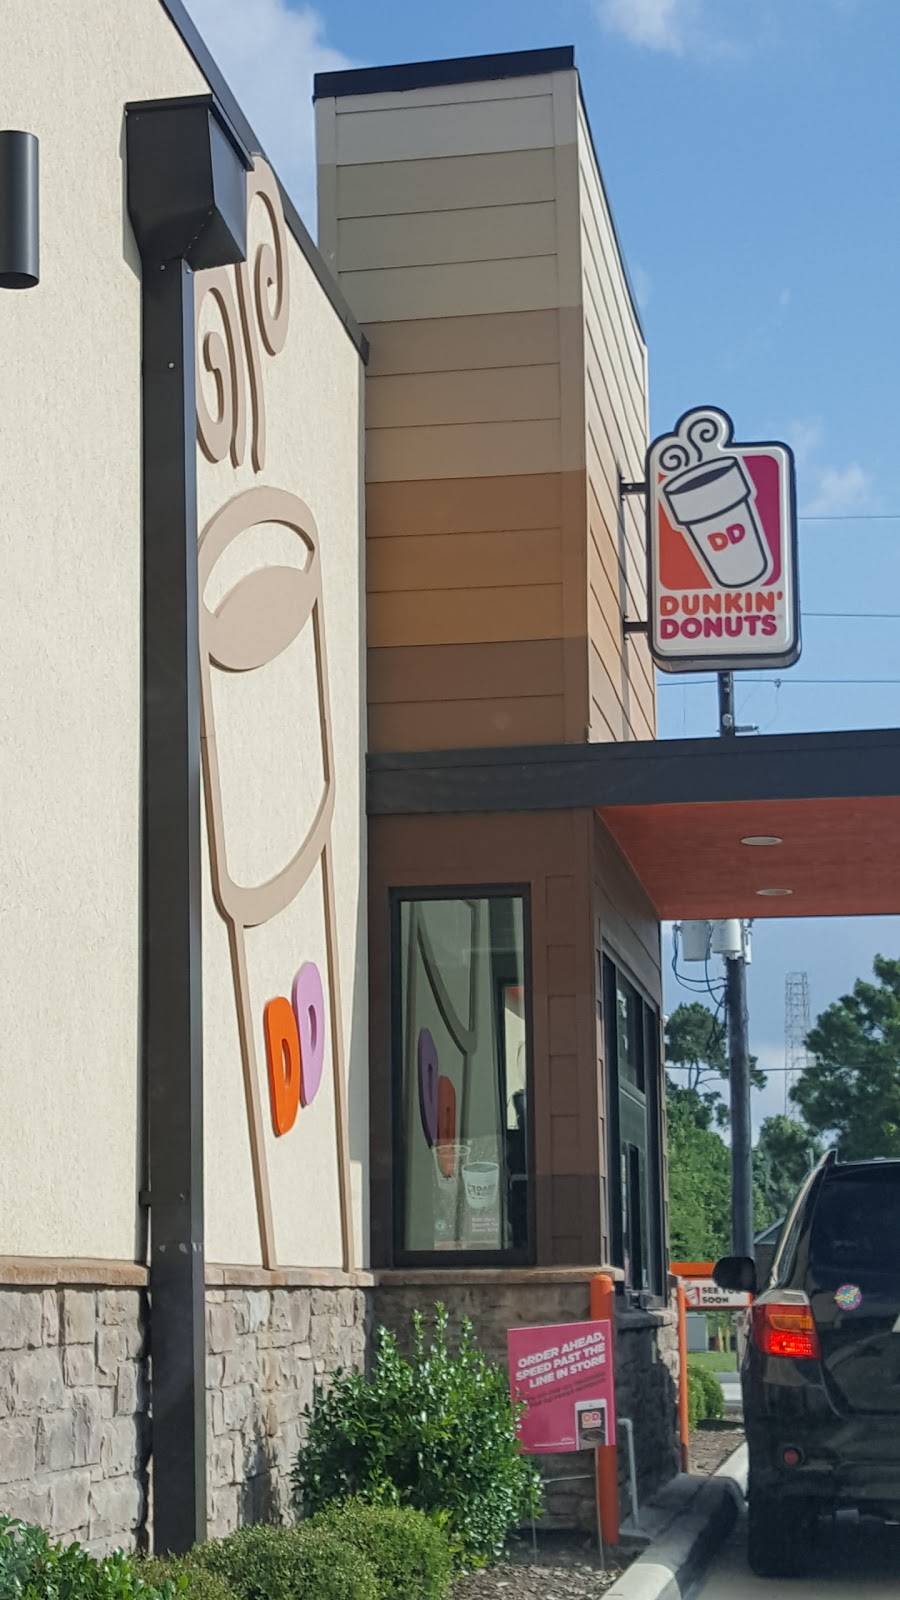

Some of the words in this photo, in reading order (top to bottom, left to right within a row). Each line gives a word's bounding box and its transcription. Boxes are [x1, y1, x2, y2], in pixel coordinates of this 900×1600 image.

[707, 523, 745, 551] DD
[659, 591, 782, 616] DUNKIN'
[659, 615, 777, 639] DONUTS
[263, 961, 325, 1138] DD
[702, 1296, 729, 1304] SOON
[515, 1362, 552, 1381] SPEED
[553, 1352, 581, 1369] PAST
[583, 1343, 606, 1358] THE
[518, 1347, 559, 1368] ORDER
[529, 1372, 555, 1388] LINE
[556, 1367, 568, 1379] IN
[569, 1354, 606, 1374] STORE
